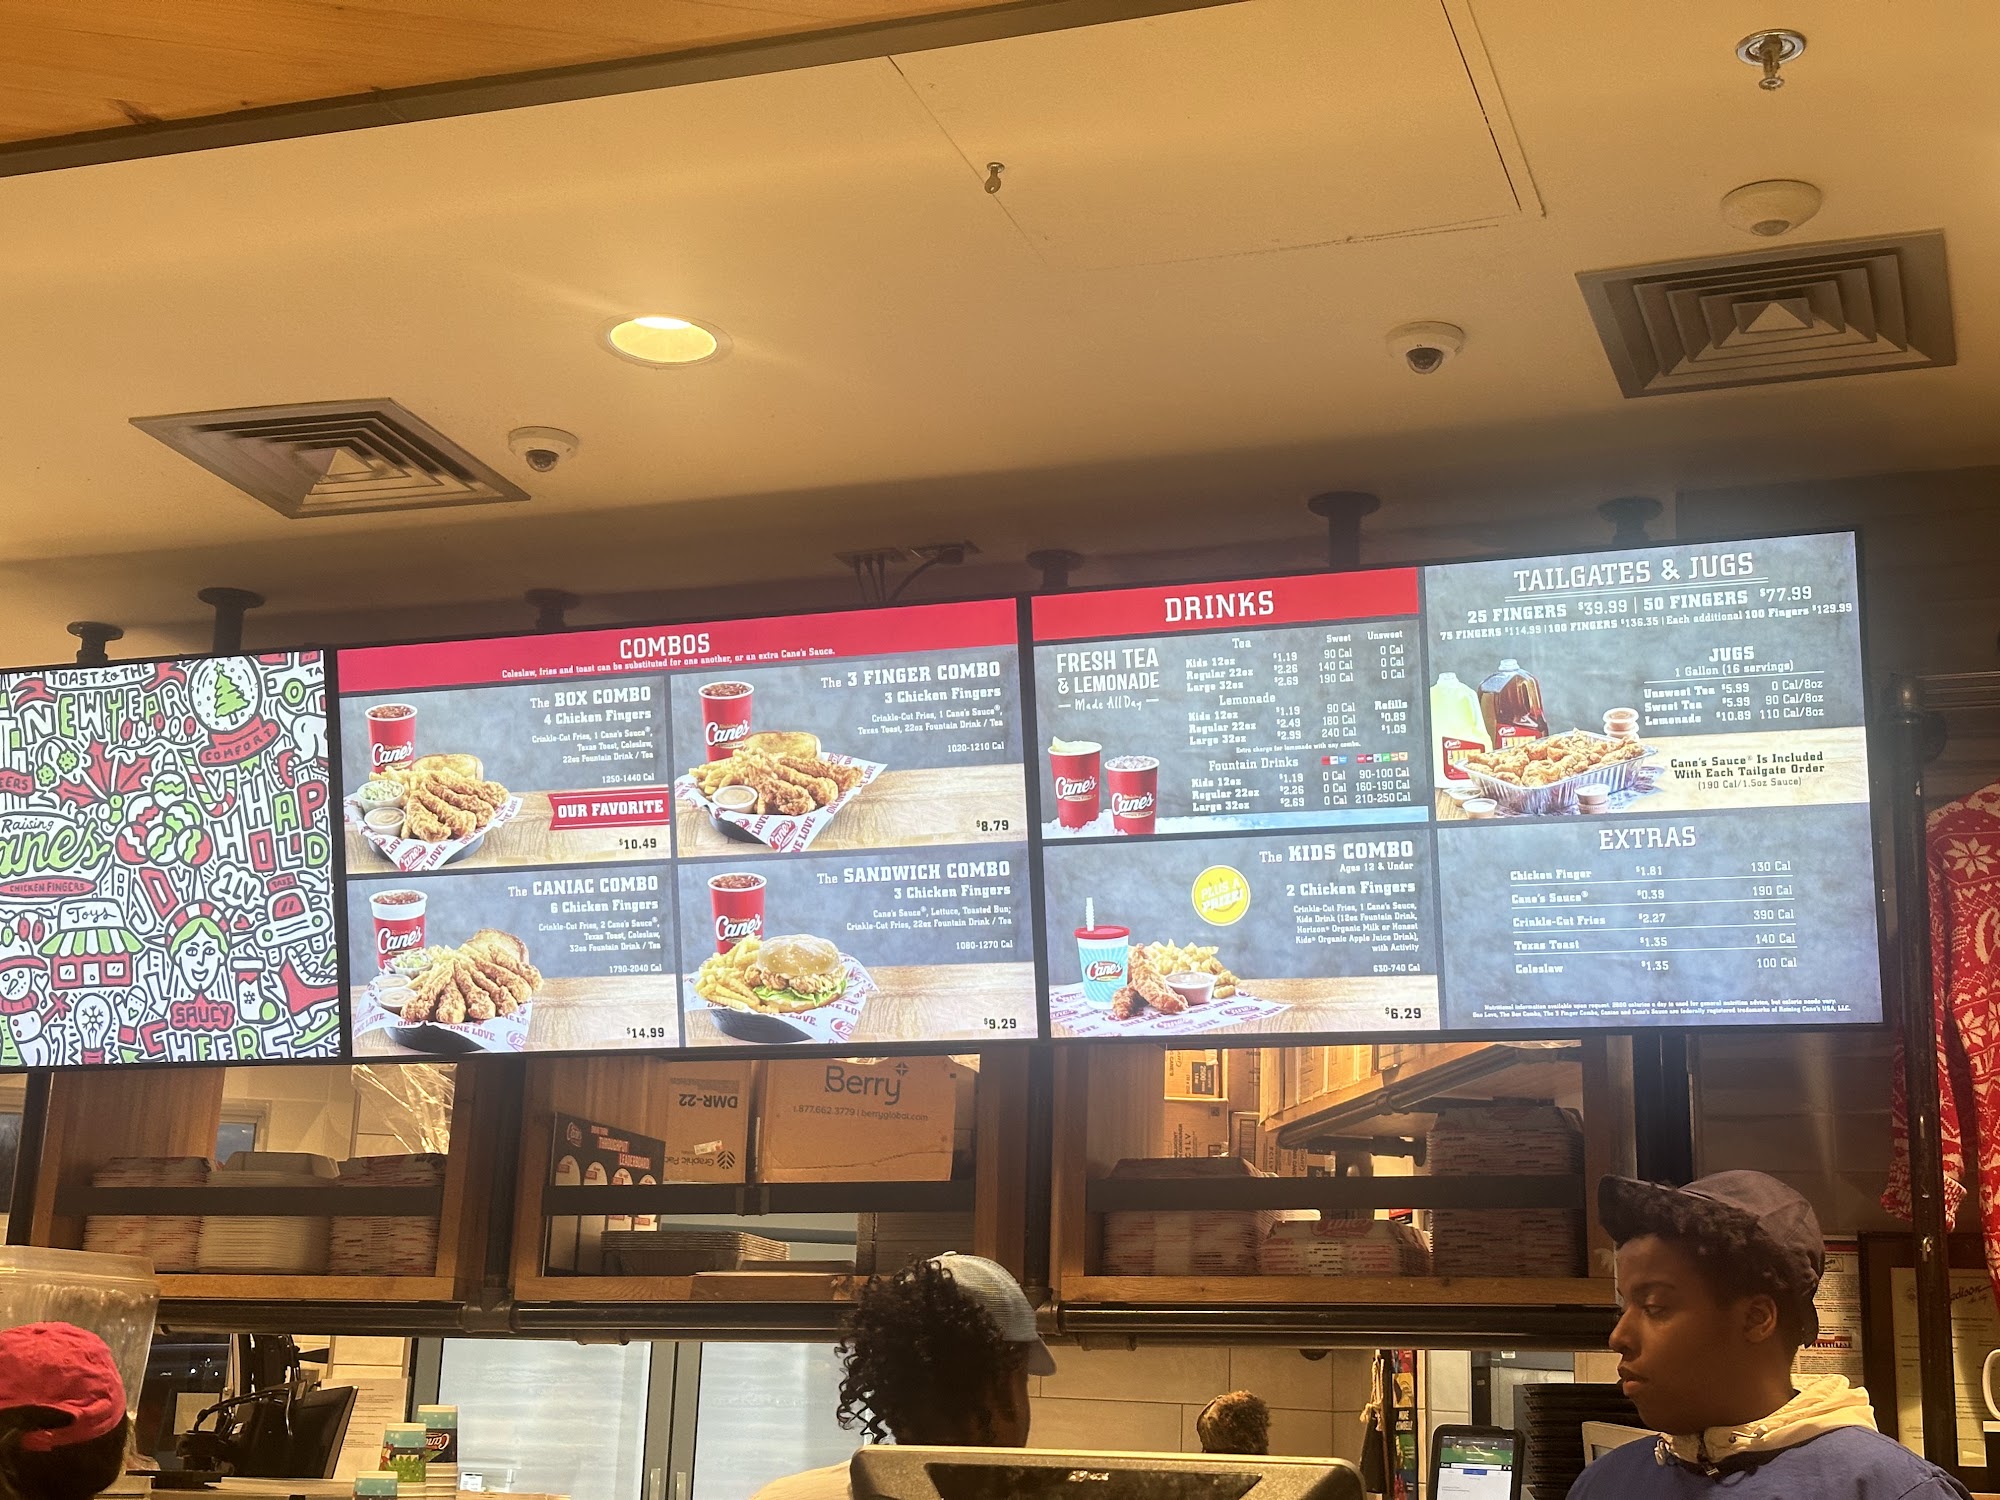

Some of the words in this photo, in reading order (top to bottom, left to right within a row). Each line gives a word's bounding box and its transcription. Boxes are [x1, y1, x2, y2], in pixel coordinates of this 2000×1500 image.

[1513, 560, 1650, 592] TAILGATES
[1660, 558, 1680, 580] &
[1688, 552, 1753, 579] JUGS
[1164, 590, 1273, 622] DRINKS
[1467, 609, 1487, 623] 25
[1492, 603, 1566, 622] FINGERS
[1577, 599, 1627, 615] $39.99
[1633, 596, 1637, 613] |
[1643, 596, 1664, 611] 50
[1669, 589, 1748, 609] FINGERS
[1759, 585, 1811, 602] $77.99
[1326, 633, 1351, 643] Sweet
[1366, 629, 1402, 640] Unsweet
[620, 632, 710, 659] COMBOS
[1231, 637, 1251, 648] Tea
[1056, 649, 1116, 673] FRESH
[1121, 647, 1159, 668] TEA
[1273, 651, 1297, 662] $1.19
[1708, 645, 1754, 662] JUGS
[502, 668, 537, 678] Coleslaw,
[539, 667, 557, 675] fries
[559, 664, 573, 674] and
[575, 664, 595, 673] toast
[612, 661, 622, 670] be
[624, 658, 667, 669] substituted
[669, 657, 681, 666] for
[700, 654, 732, 664] another,
[758, 651, 778, 660] extra
[780, 648, 806, 658] Cane's
[808, 647, 835, 656] Sauce.
[1273, 663, 1298, 674] $2.26
[1674, 667, 1680, 677] 1
[1684, 665, 1718, 676] Gallon
[1719, 663, 1740, 677] (16
[1743, 659, 1793, 672] servings)
[51, 671, 98, 686] TOAST
[101, 669, 119, 683] to
[119, 665, 150, 681] THE
[820, 676, 841, 688] The
[847, 671, 857, 686] 3
[863, 666, 931, 685] FINGER
[937, 661, 1000, 680] COMBO
[1273, 675, 1298, 686] $2.69
[1057, 677, 1069, 694] &
[1074, 671, 1160, 693] LEMONADE
[1721, 682, 1749, 693] $5.99
[529, 697, 549, 708] The
[554, 690, 587, 707] BOX
[592, 686, 650, 704] COMBO
[884, 691, 892, 703] 3
[896, 689, 947, 703] Chicken
[951, 686, 1001, 700] Fingers
[1218, 691, 1275, 705] Lemonade
[1721, 696, 1750, 707] $5.99
[1075, 698, 1103, 711] Made
[1106, 695, 1121, 709] All
[1123, 694, 1141, 711] Day
[1374, 699, 1407, 710] Refills
[543, 713, 551, 725] 4
[555, 711, 602, 724] Chicken
[605, 709, 651, 722] Fingers
[1275, 705, 1300, 716] $1.19
[1380, 711, 1405, 722] $0.89
[1715, 710, 1751, 721] $10.89
[1276, 717, 1300, 728] $2.49
[1381, 723, 1406, 734] $1.09
[705, 719, 750, 746] Cane's
[1276, 730, 1301, 740] $2.99
[205, 728, 275, 761] COMFORT
[947, 742, 989, 752] 1020-1210
[991, 741, 1004, 749] Cal
[371, 741, 413, 766] Cane's
[1670, 757, 1706, 768] Cane's
[1756, 754, 1767, 767] Is
[1772, 750, 1823, 765] Included
[1208, 759, 1257, 771] Fountain
[1260, 755, 1298, 768] Drinks
[601, 773, 641, 783] 1250-1440
[642, 772, 654, 781] Cal
[1278, 772, 1303, 783] $1.19
[1674, 768, 1701, 779] With
[1705, 767, 1733, 777] Each
[1737, 765, 1785, 777] Tailgate
[1791, 763, 1824, 773] Order
[1056, 775, 1097, 799] Cane's
[1279, 784, 1304, 795] $2.26
[557, 803, 587, 818] OUR
[591, 799, 663, 816] FAVORITE
[1112, 792, 1154, 815] Cane's
[1279, 797, 1304, 807] $2.69
[2, 818, 54, 833] Raising
[976, 819, 1008, 831] $8.79
[618, 838, 656, 849] $10.49
[1598, 825, 1696, 850] EXTRAS
[1258, 850, 1282, 862] The
[1288, 843, 1335, 861] KIDS
[1342, 840, 1413, 859] COMBO
[816, 872, 837, 884] The
[843, 863, 940, 883] SANDWICH
[946, 860, 1010, 878] COMBO
[1635, 865, 1662, 876] $1.81
[10, 882, 44, 892] CHICKEN
[47, 881, 85, 892] FINGERS
[507, 885, 527, 897] The
[532, 878, 594, 895] CANIAC
[599, 875, 657, 892] COMBO
[893, 887, 901, 899] 3
[906, 885, 957, 898] Chicken
[960, 884, 1010, 898] Fingers
[1286, 884, 1295, 896] 2
[1299, 882, 1356, 896] Chicken
[1359, 880, 1415, 896] Fingers
[1636, 889, 1664, 899] $0.39
[550, 902, 558, 913] 6
[562, 900, 609, 913] Chicken
[612, 898, 658, 913] Fingers
[66, 905, 117, 923] Toys
[1638, 912, 1665, 923] $2.27
[715, 914, 762, 941] Cane's
[377, 925, 422, 954] Cane's
[1639, 936, 1667, 947] $1.35
[1640, 960, 1668, 970] $1.35
[175, 1005, 230, 1025] SAUCY
[1384, 1006, 1421, 1019] $6.29
[983, 1017, 1016, 1029] $9.29
[626, 1027, 664, 1038] $14.99
[825, 1065, 903, 1105] Berry
[679, 1092, 738, 1109] DMR-22
